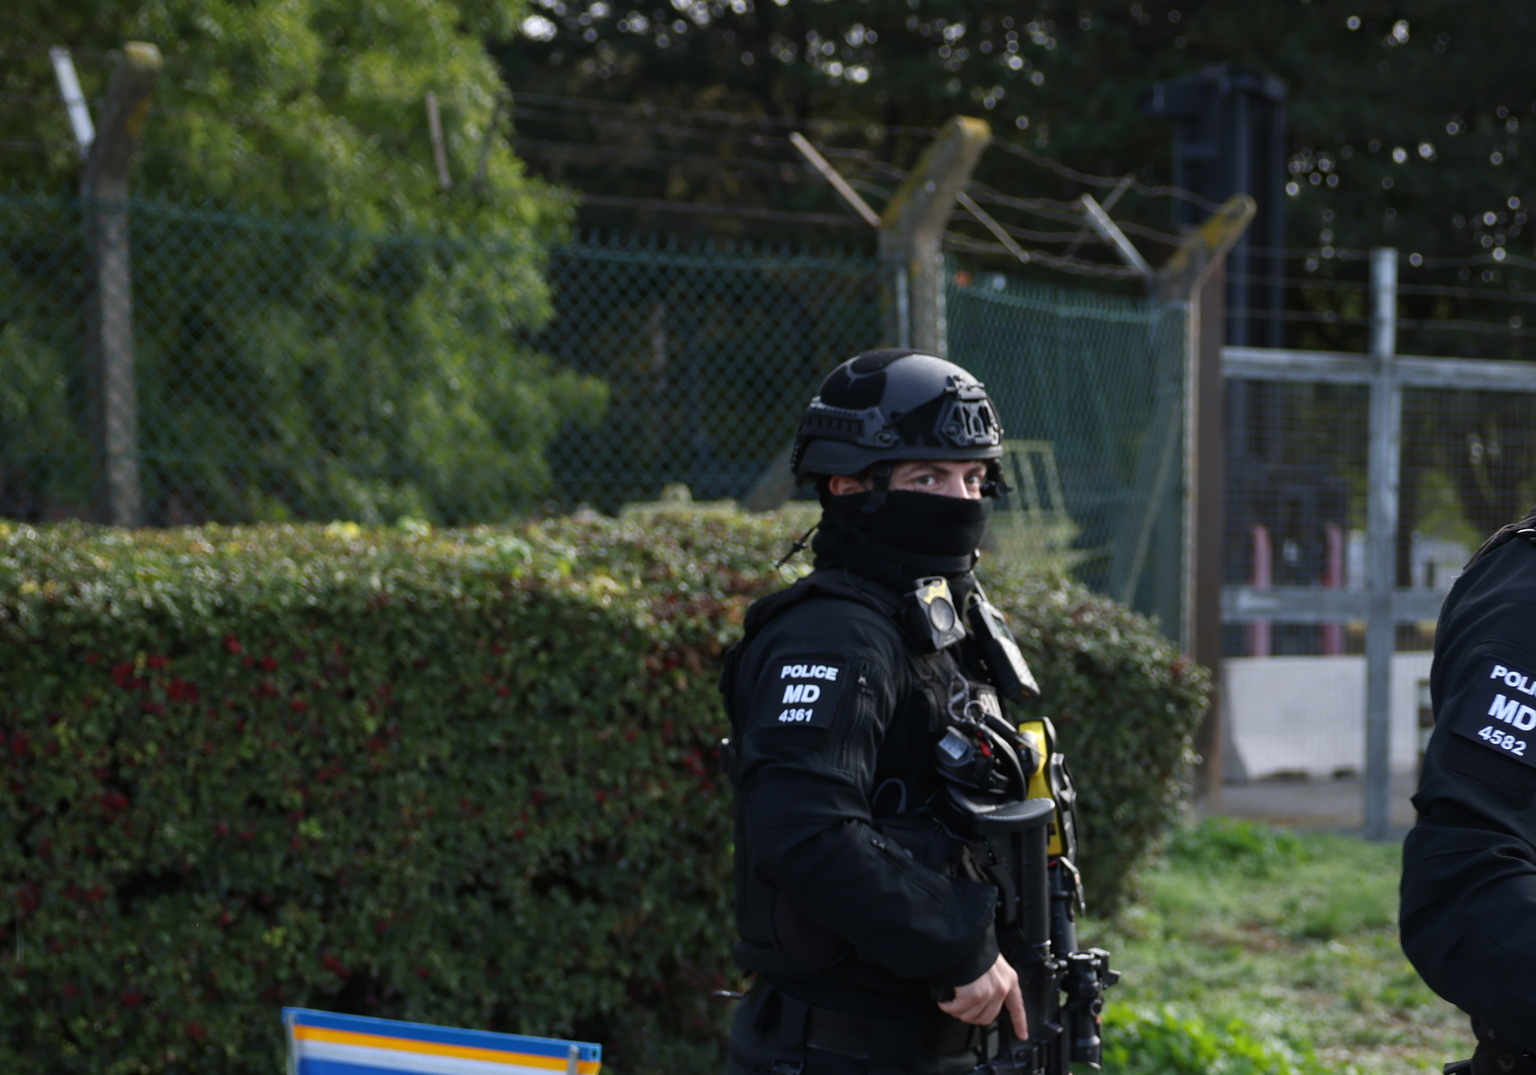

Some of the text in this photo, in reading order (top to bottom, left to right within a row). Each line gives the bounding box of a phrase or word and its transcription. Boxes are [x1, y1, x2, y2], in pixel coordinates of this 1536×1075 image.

[780, 664, 839, 681] POLICE
[782, 684, 821, 704] MD
[778, 708, 814, 723] 4361
[1477, 725, 1527, 756] 4582
